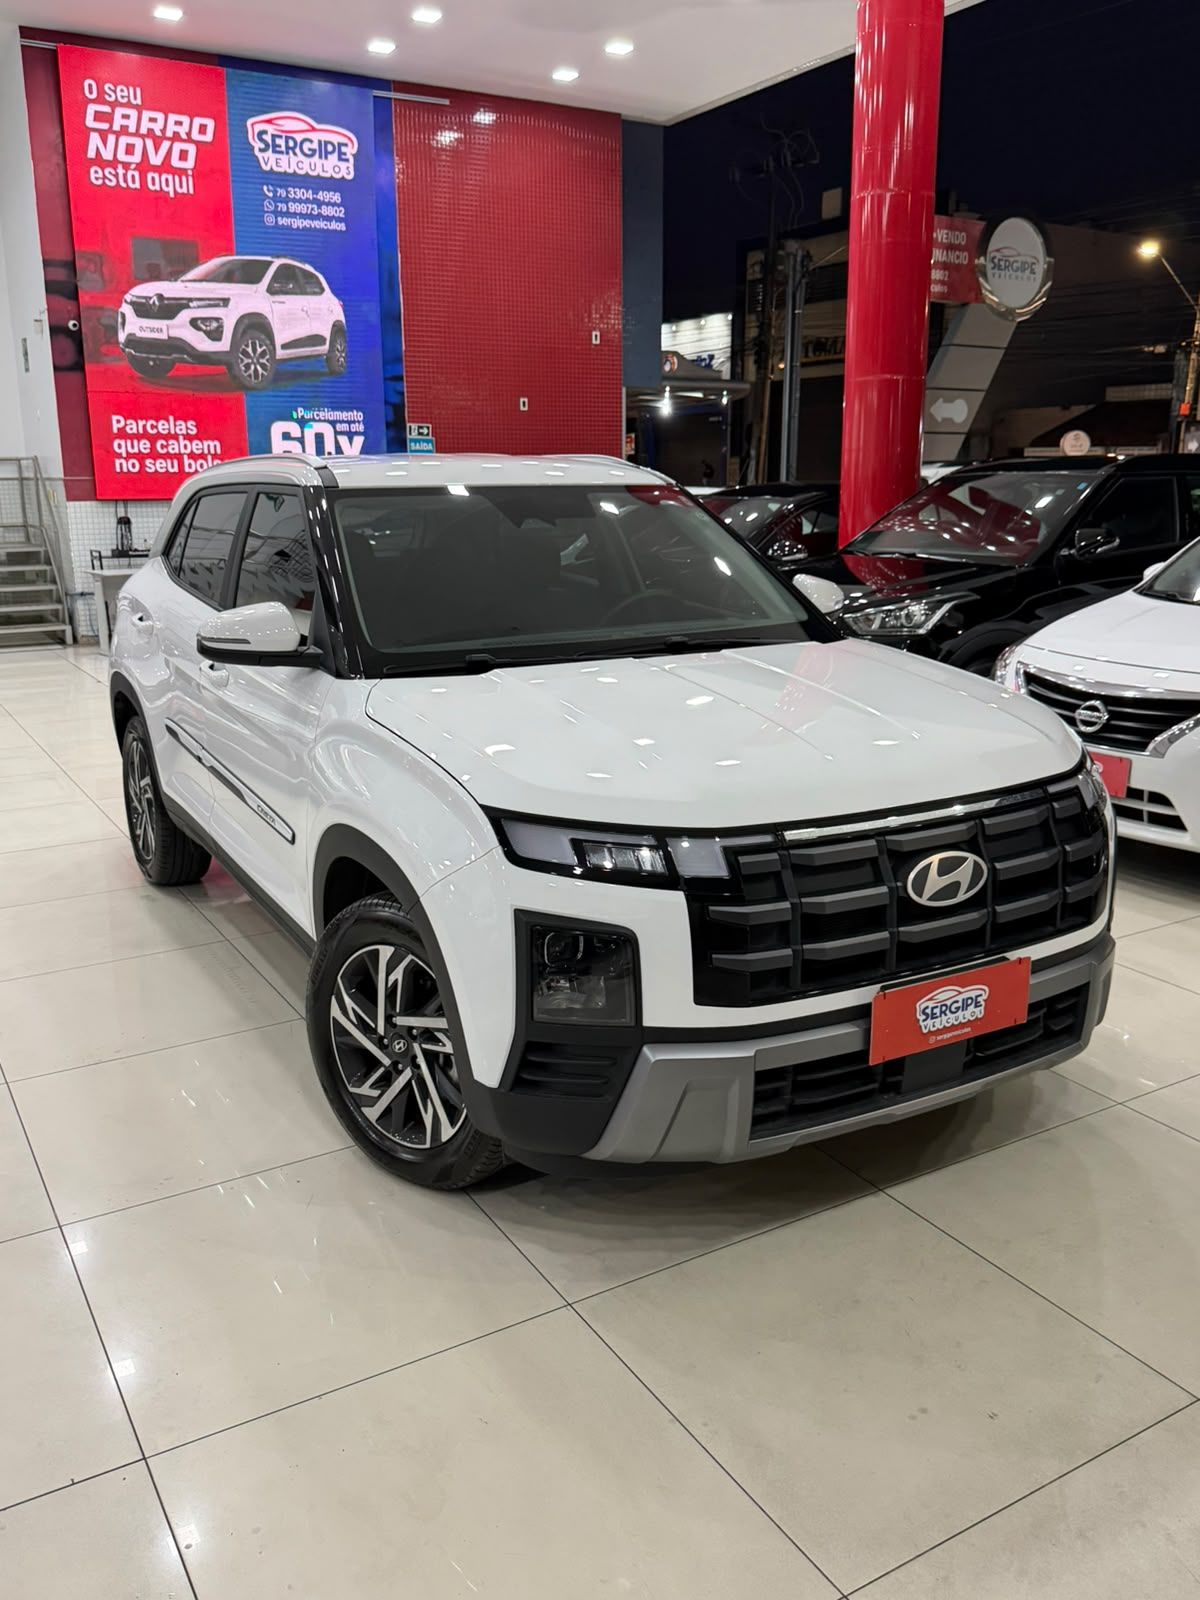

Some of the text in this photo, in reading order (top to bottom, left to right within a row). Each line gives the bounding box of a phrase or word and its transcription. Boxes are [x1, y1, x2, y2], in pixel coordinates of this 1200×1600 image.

[83, 78, 142, 106] O seu
[85, 103, 215, 142] CARRO
[87, 131, 197, 169] NOVO
[256, 129, 350, 162] SERGIPE
[261, 155, 351, 176] VEÍCULOS
[90, 163, 194, 198] está aqui
[276, 187, 341, 203] 79 3304-4956
[288, 202, 345, 218] 99973-8802
[277, 216, 346, 231] sergipeveiculos
[991, 256, 1036, 275] SERGIPE
[297, 407, 364, 421] Parcelamento
[111, 415, 198, 435] Parcelas
[336, 422, 364, 432] em até
[113, 436, 221, 457] que cabem
[410, 441, 433, 451] SAÍDA
[115, 458, 140, 473] no
[145, 459, 179, 473] seu
[921, 994, 983, 1023] SERGIPE
